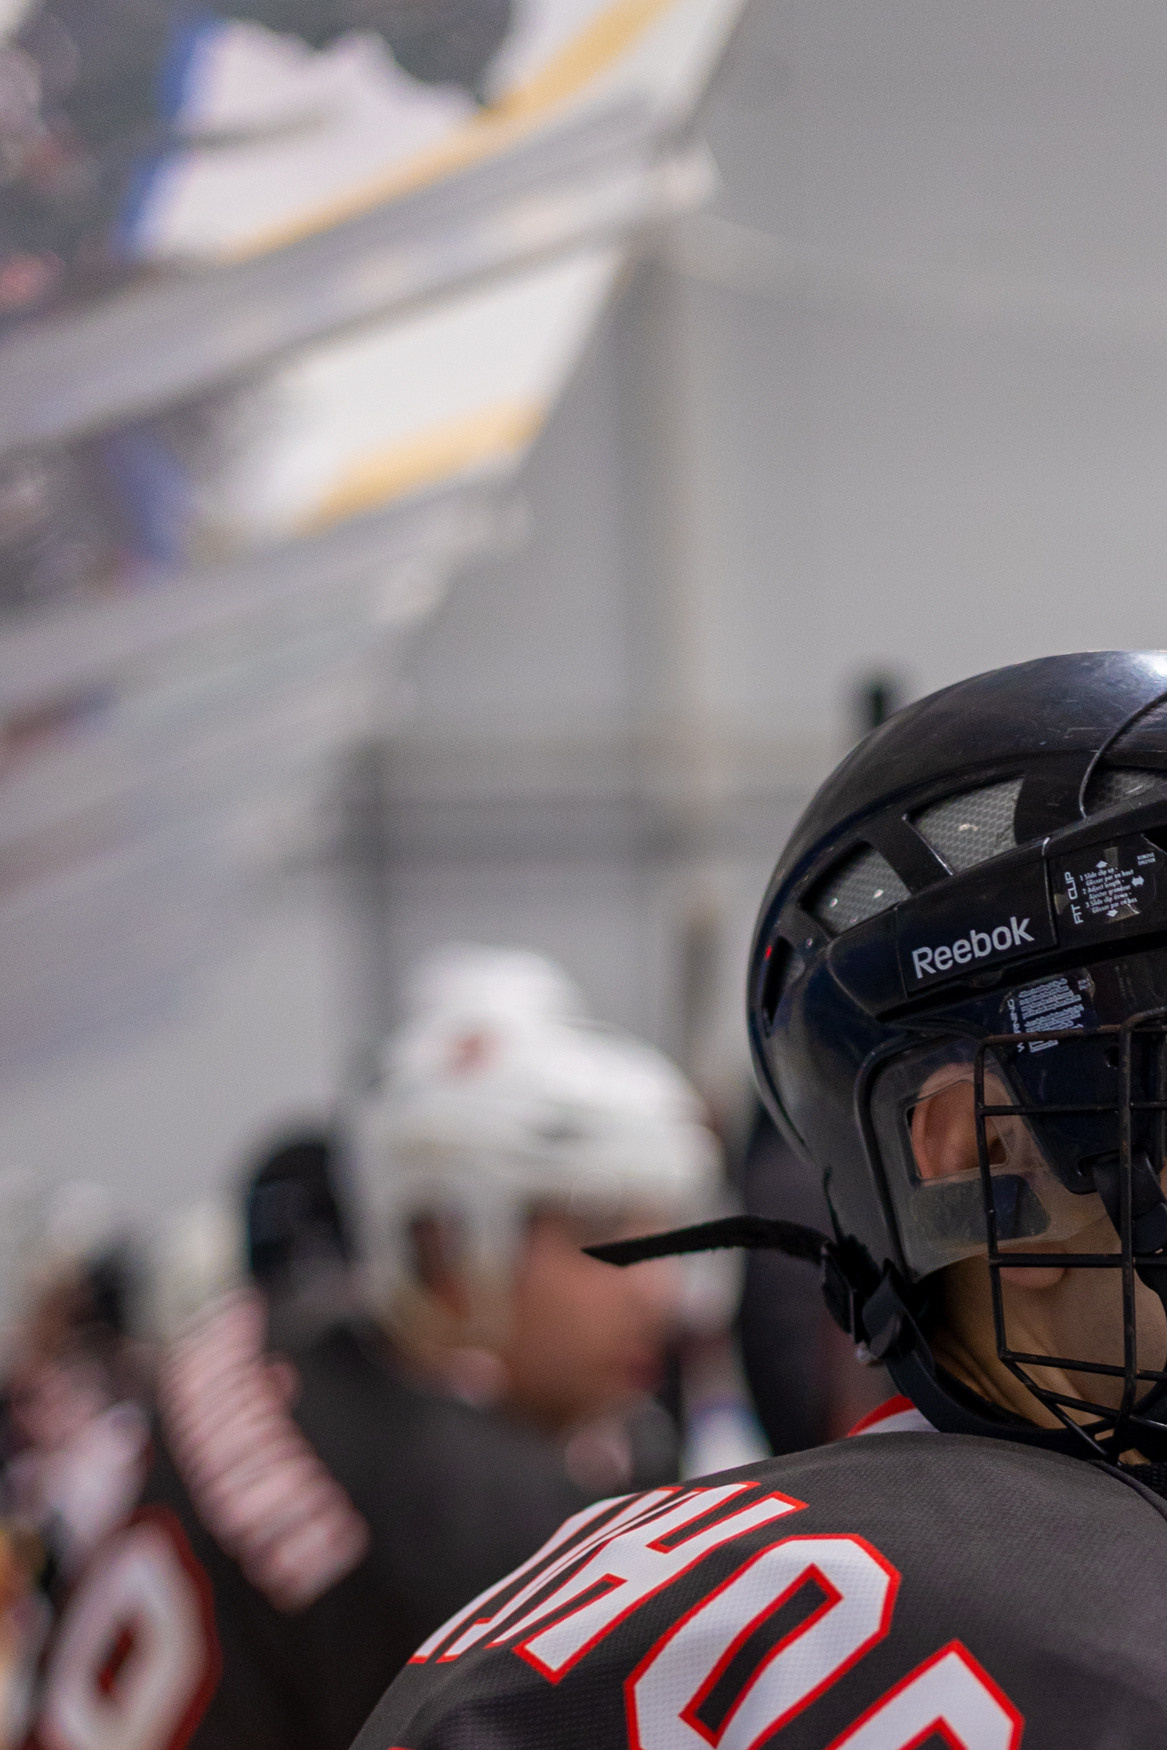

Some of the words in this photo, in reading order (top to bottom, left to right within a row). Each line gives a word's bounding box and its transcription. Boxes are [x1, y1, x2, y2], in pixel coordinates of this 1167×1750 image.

[1064, 871, 1078, 900] CLIP
[1070, 904, 1084, 925] FIT
[911, 915, 1036, 980] Reebok
[1007, 998, 1026, 1053] WRNING
